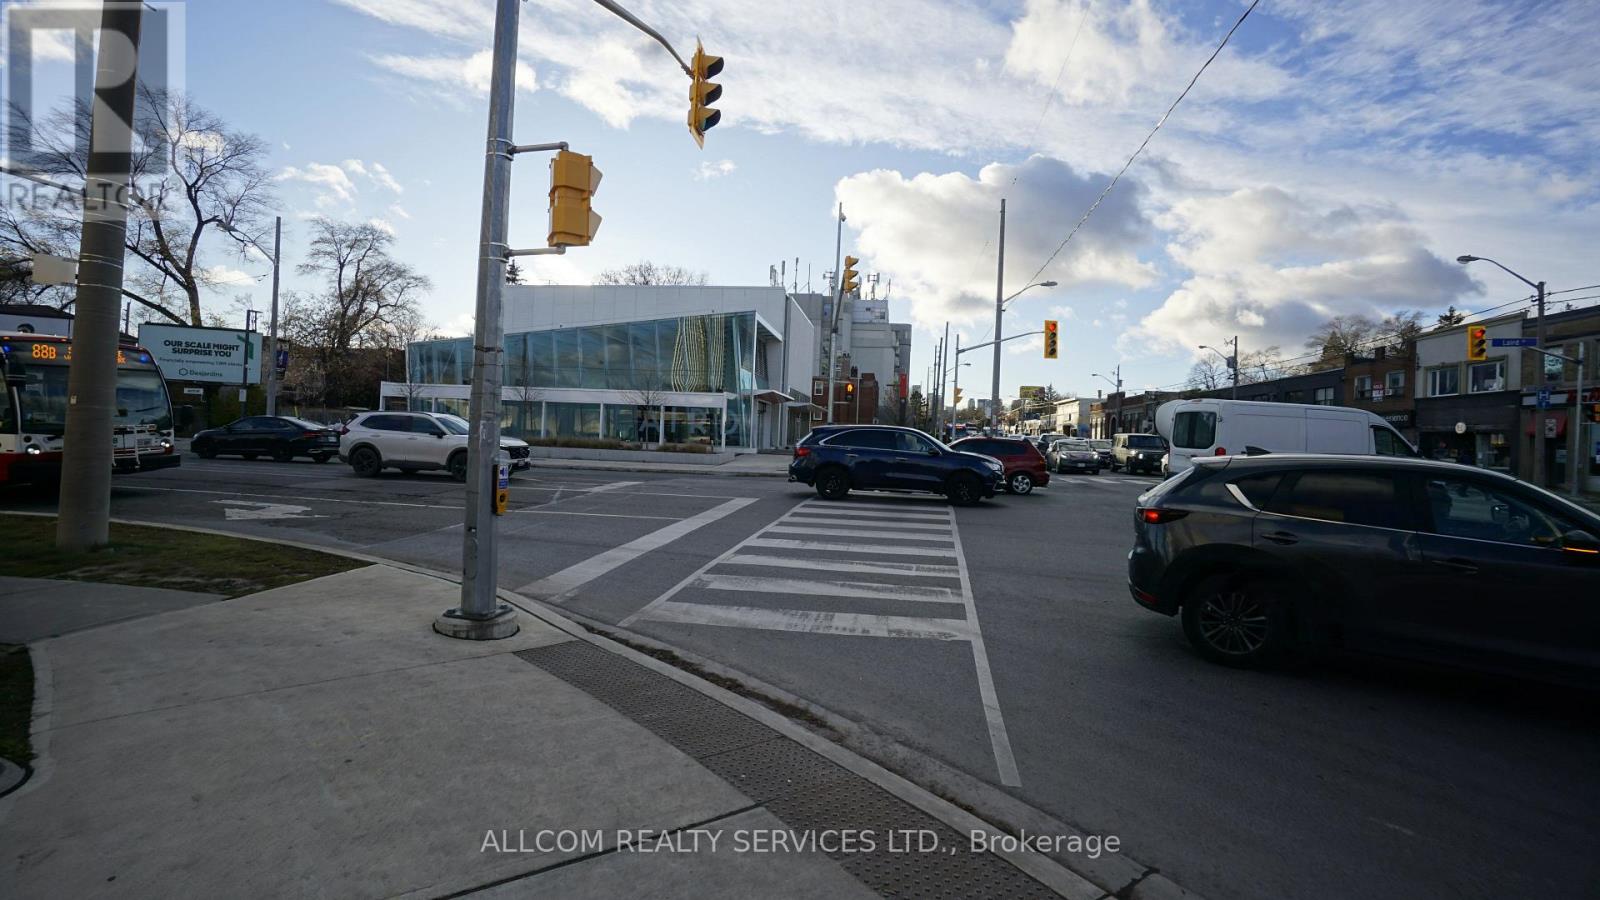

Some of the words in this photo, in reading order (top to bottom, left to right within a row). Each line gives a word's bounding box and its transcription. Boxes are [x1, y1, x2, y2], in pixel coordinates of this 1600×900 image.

[32, 343, 56, 360] 88B
[163, 340, 183, 348] OUR
[184, 341, 211, 350] SCALE
[212, 343, 240, 352] MIGHT
[172, 347, 213, 357] SURPRISE
[214, 350, 232, 358] YOU
[1540, 391, 1549, 400] H
